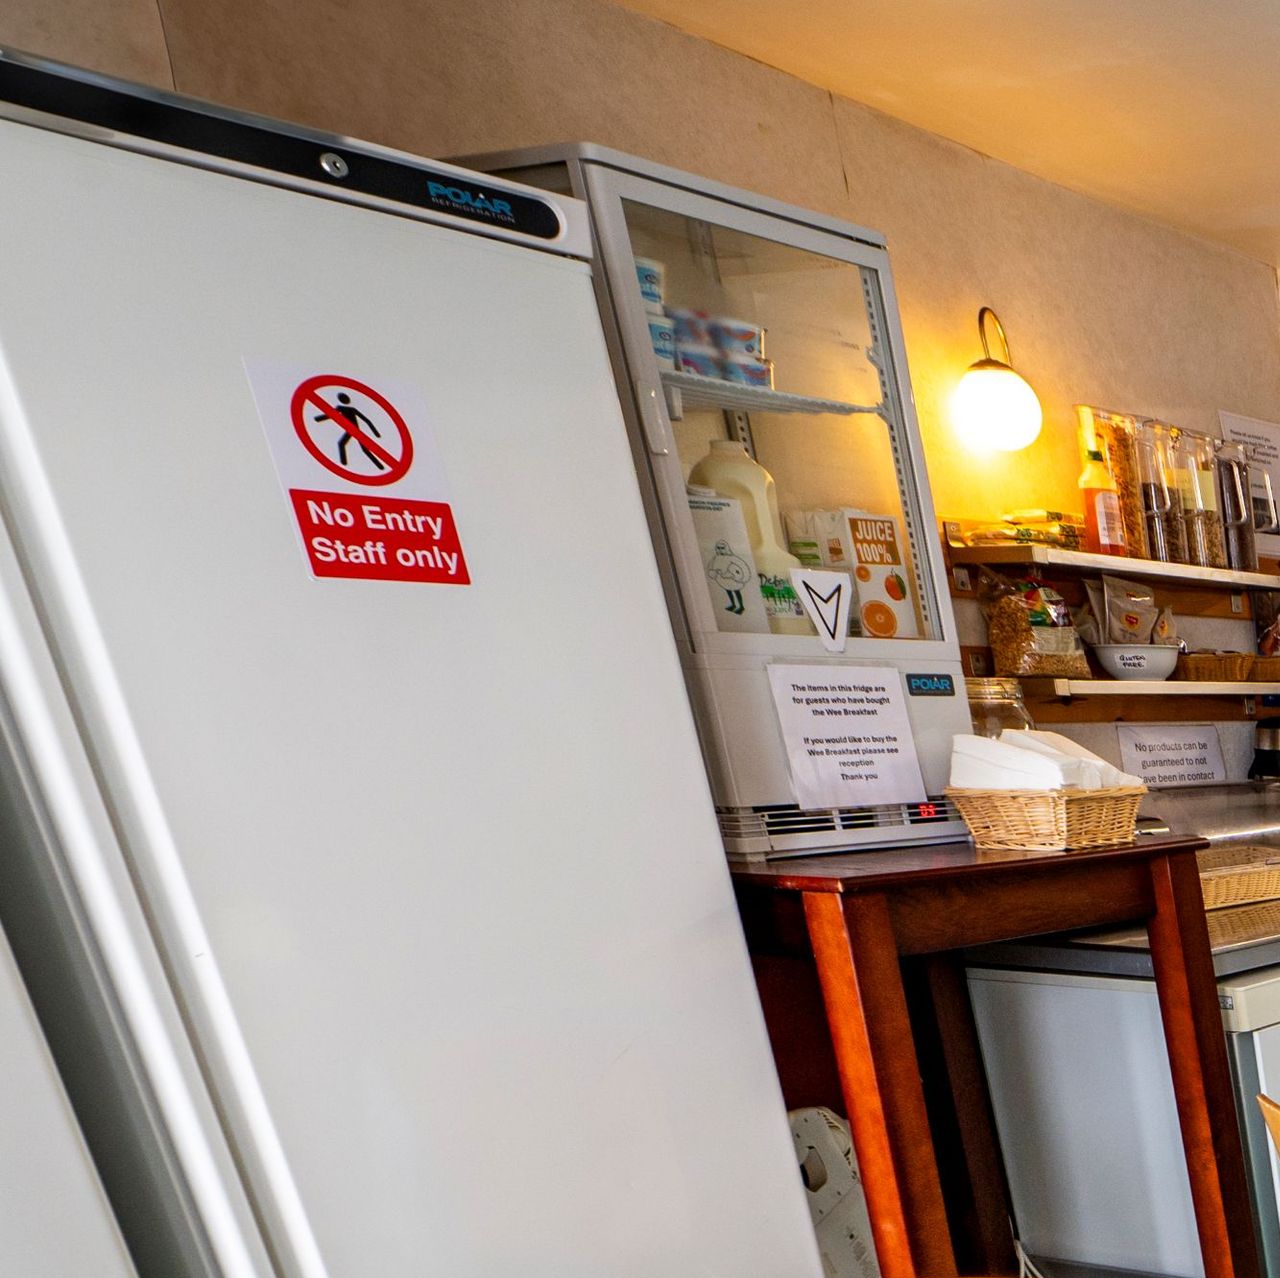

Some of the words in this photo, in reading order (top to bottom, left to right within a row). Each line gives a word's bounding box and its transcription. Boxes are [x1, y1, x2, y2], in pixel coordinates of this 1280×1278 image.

[426, 181, 512, 215] POLAR
[432, 197, 515, 224] REFRIGERATION
[306, 499, 355, 528] No
[361, 504, 443, 540] Entry
[855, 520, 894, 542] JUICE
[311, 536, 388, 566] Staff
[396, 546, 458, 576] only
[856, 543, 894, 563] 100%
[791, 684, 806, 692] The
[807, 684, 829, 692] items
[830, 684, 837, 692] in
[838, 684, 852, 692] this
[852, 684, 873, 693] fridge
[911, 676, 951, 690] POLAR
[805, 697, 830, 706] guests
[831, 696, 846, 704] who
[847, 696, 864, 704] have
[865, 696, 890, 706] bought
[812, 708, 825, 716] the
[826, 708, 842, 716] Wee
[843, 708, 878, 716] Breakfast
[825, 736, 847, 744] would
[872, 736, 885, 745] buy
[807, 749, 824, 757] Wee
[826, 748, 861, 756] Breakfast
[862, 747, 885, 756] please
[1135, 743, 1147, 752] No
[1148, 742, 1182, 753] products
[1183, 742, 1197, 751] can
[1198, 741, 1208, 750] be
[839, 760, 874, 768] reception
[1141, 758, 1184, 770] guaranteed
[1185, 758, 1194, 766] to
[1195, 757, 1208, 766] not
[841, 773, 864, 781] Thank
[865, 774, 878, 782] you
[1158, 773, 1177, 783] been
[1178, 772, 1186, 781] in
[1187, 771, 1215, 781] contact
